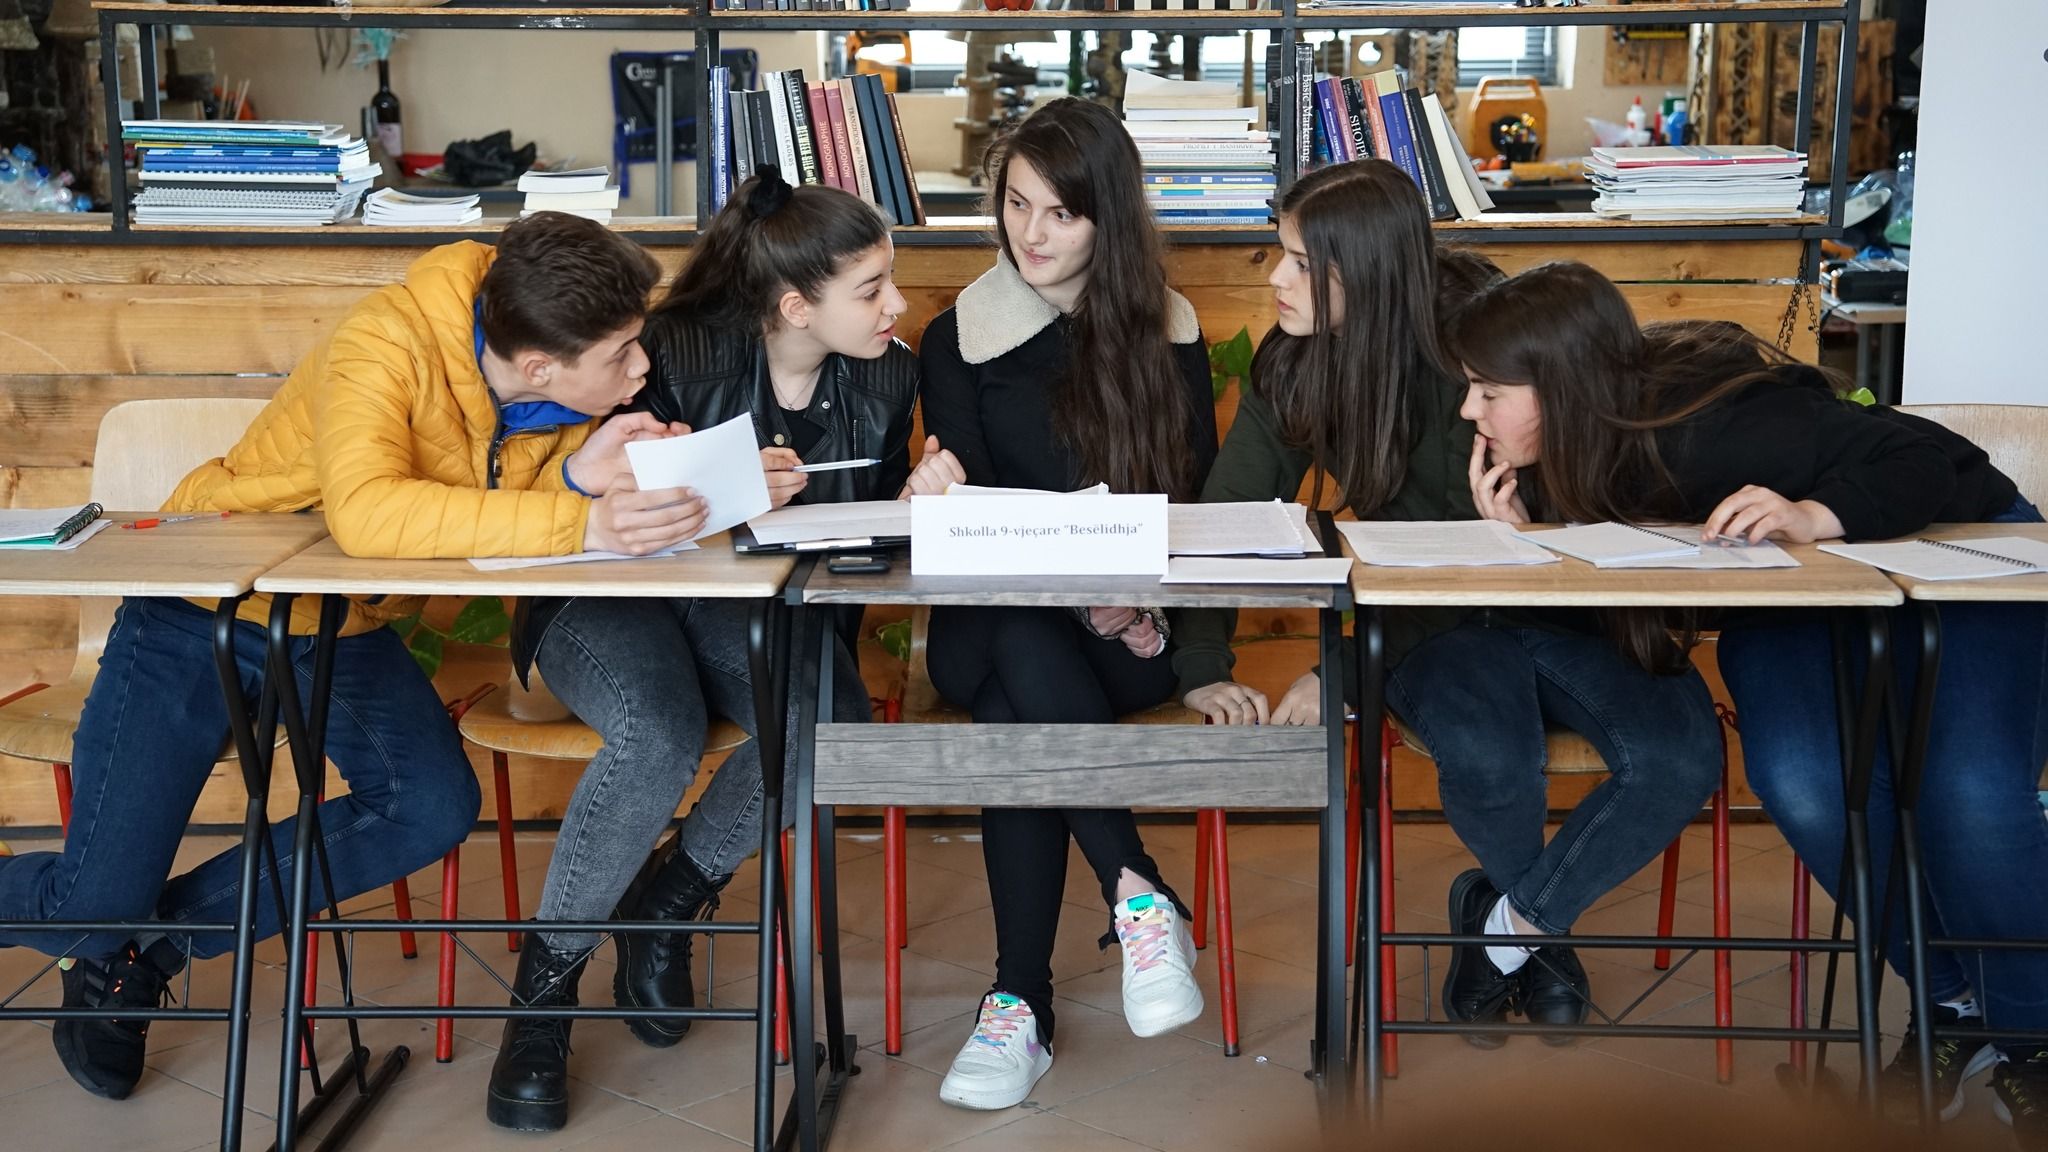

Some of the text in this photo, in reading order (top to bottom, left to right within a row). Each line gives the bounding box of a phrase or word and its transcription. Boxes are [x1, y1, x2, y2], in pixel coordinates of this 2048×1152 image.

[1302, 74, 1313, 102] Basic
[784, 135, 795, 168] LEADERS
[819, 121, 836, 178] MONOGRAPHIE
[835, 121, 851, 178] MONOGRAPHIE
[1301, 105, 1313, 162] Marketing
[949, 526, 997, 537] Shkolla
[1000, 525, 1061, 539] 9-vjeçare
